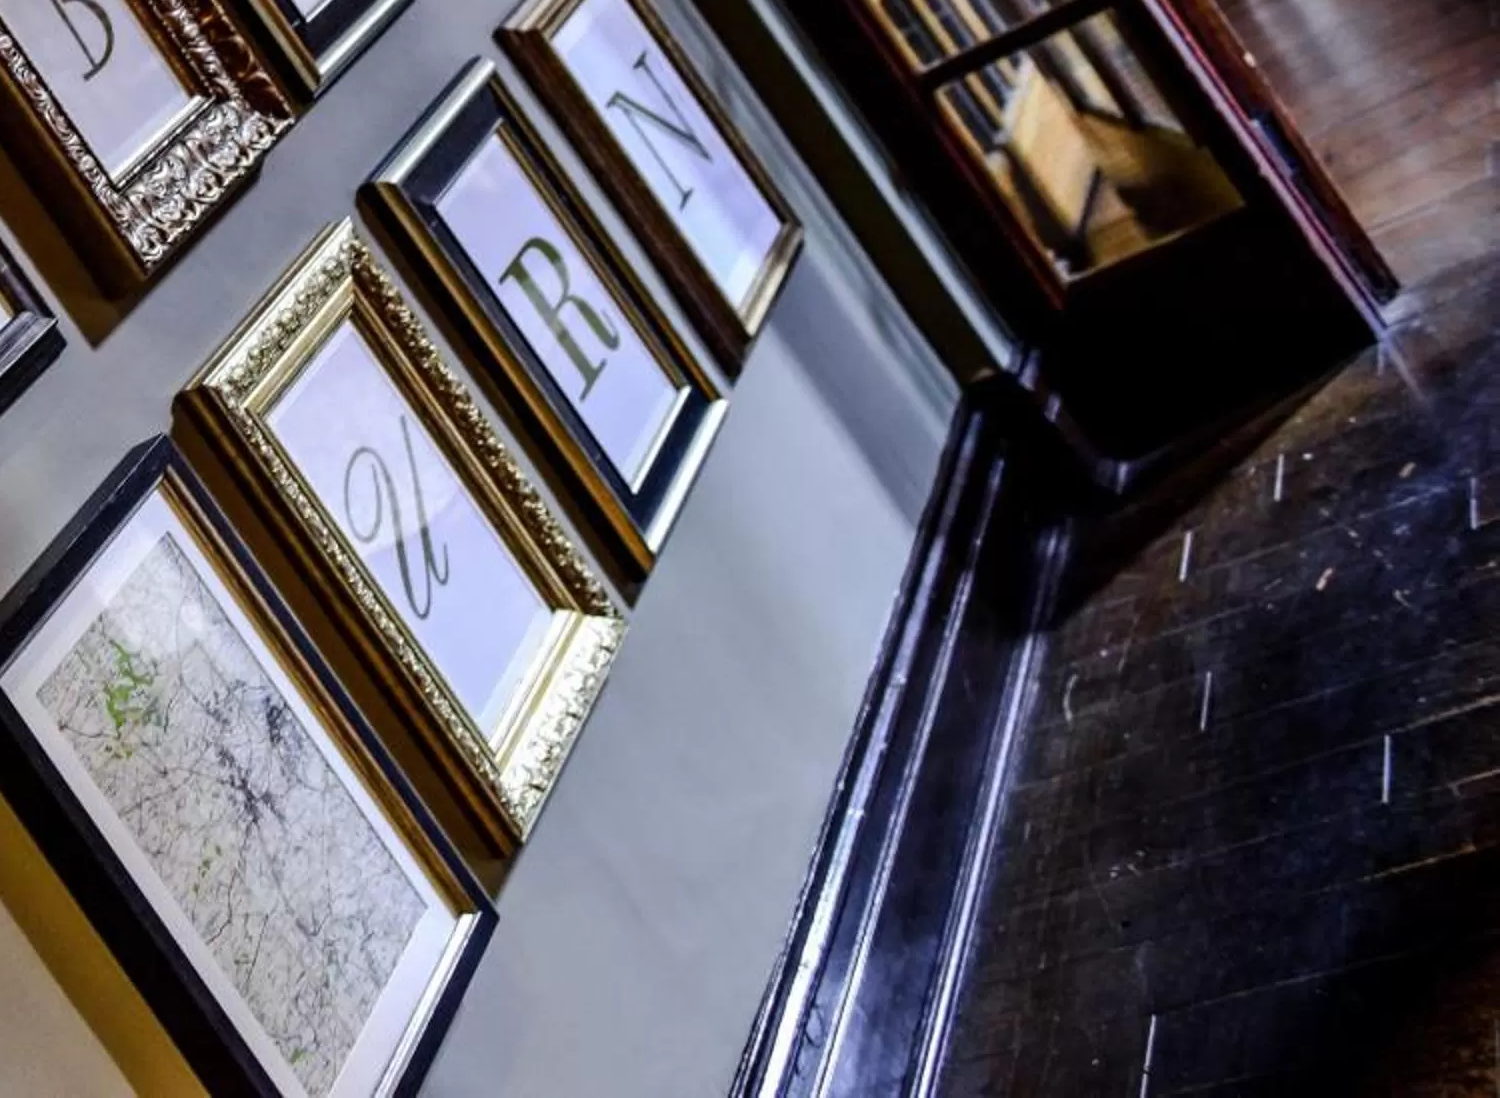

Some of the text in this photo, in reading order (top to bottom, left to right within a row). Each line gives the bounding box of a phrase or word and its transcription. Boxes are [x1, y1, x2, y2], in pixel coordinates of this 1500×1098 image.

[344, 50, 712, 621] U R N
